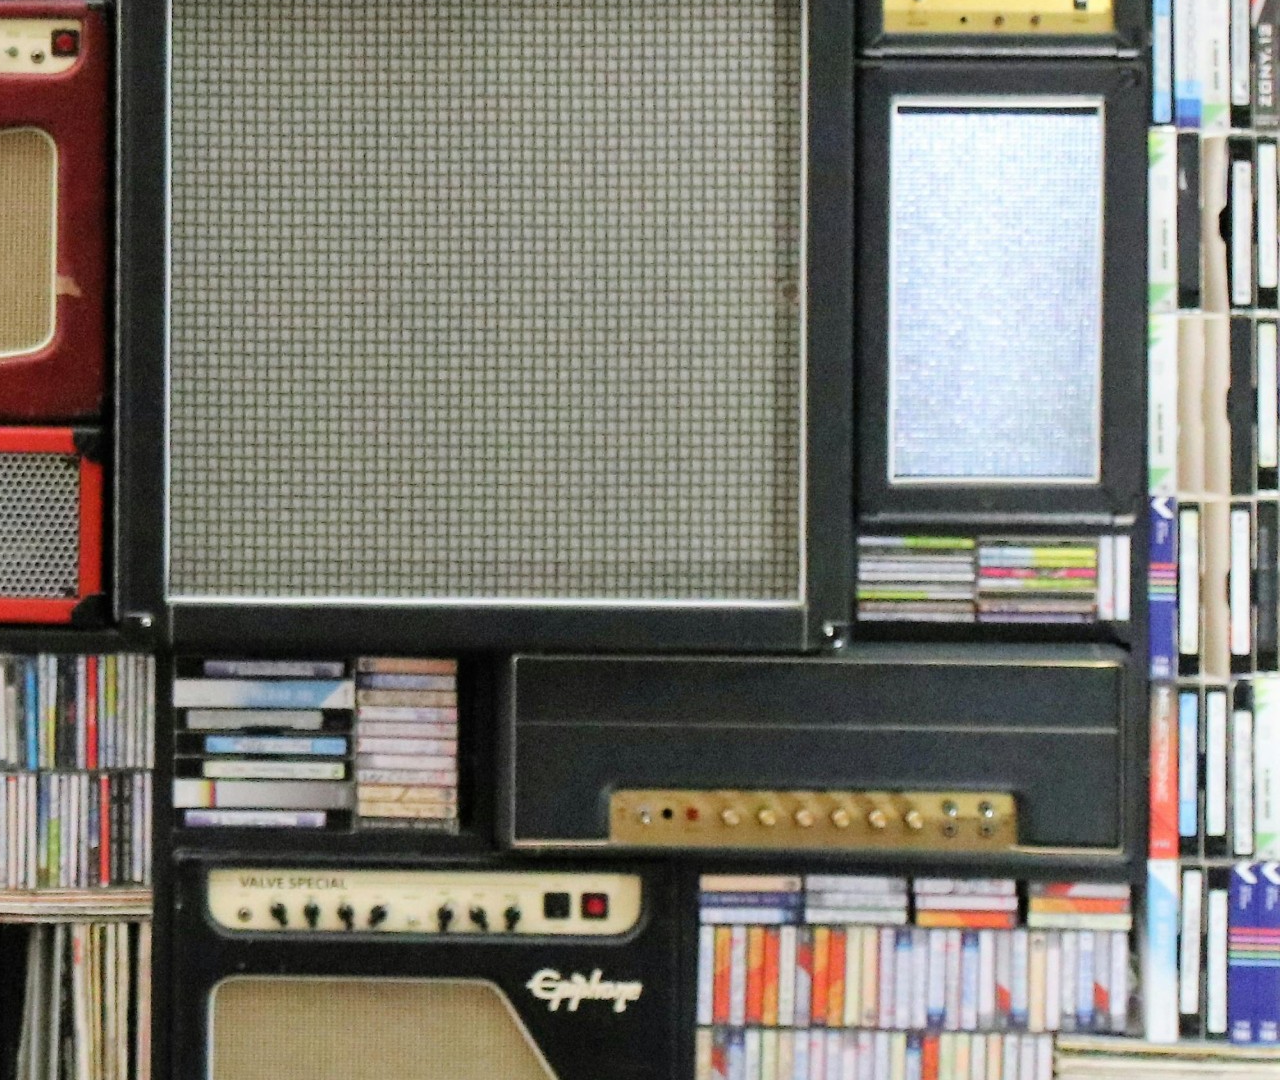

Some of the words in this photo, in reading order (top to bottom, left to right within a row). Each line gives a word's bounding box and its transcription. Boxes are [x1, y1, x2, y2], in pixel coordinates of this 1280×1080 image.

[239, 877, 283, 888] VALVE
[289, 877, 348, 890] SPECIAL
[527, 968, 641, 1012] Epiphone
